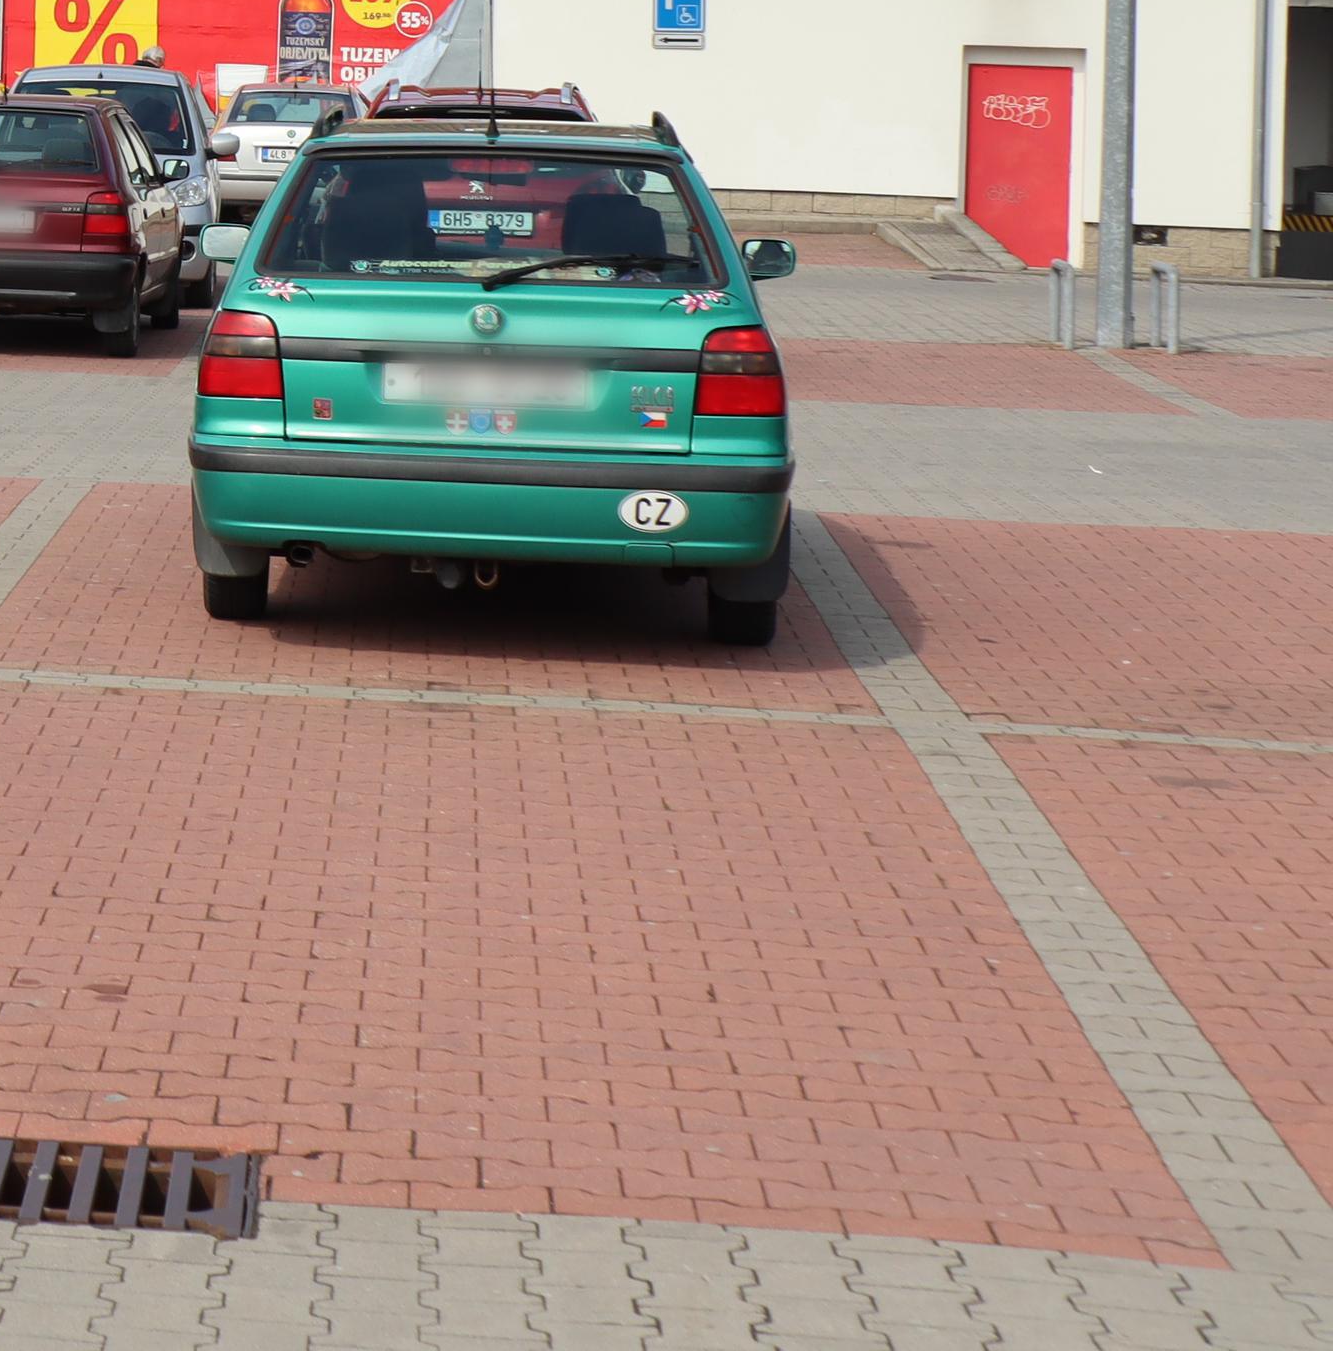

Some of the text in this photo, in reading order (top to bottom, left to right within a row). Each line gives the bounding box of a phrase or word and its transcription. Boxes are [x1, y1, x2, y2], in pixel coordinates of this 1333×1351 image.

[401, 11, 430, 28] 35%
[285, 36, 325, 46] TUZEMSKÝ
[280, 46, 330, 61] OBJEVITEL
[340, 47, 400, 63] TUZEM
[443, 212, 525, 229] 6H5 8379
[635, 497, 672, 526] CZ
